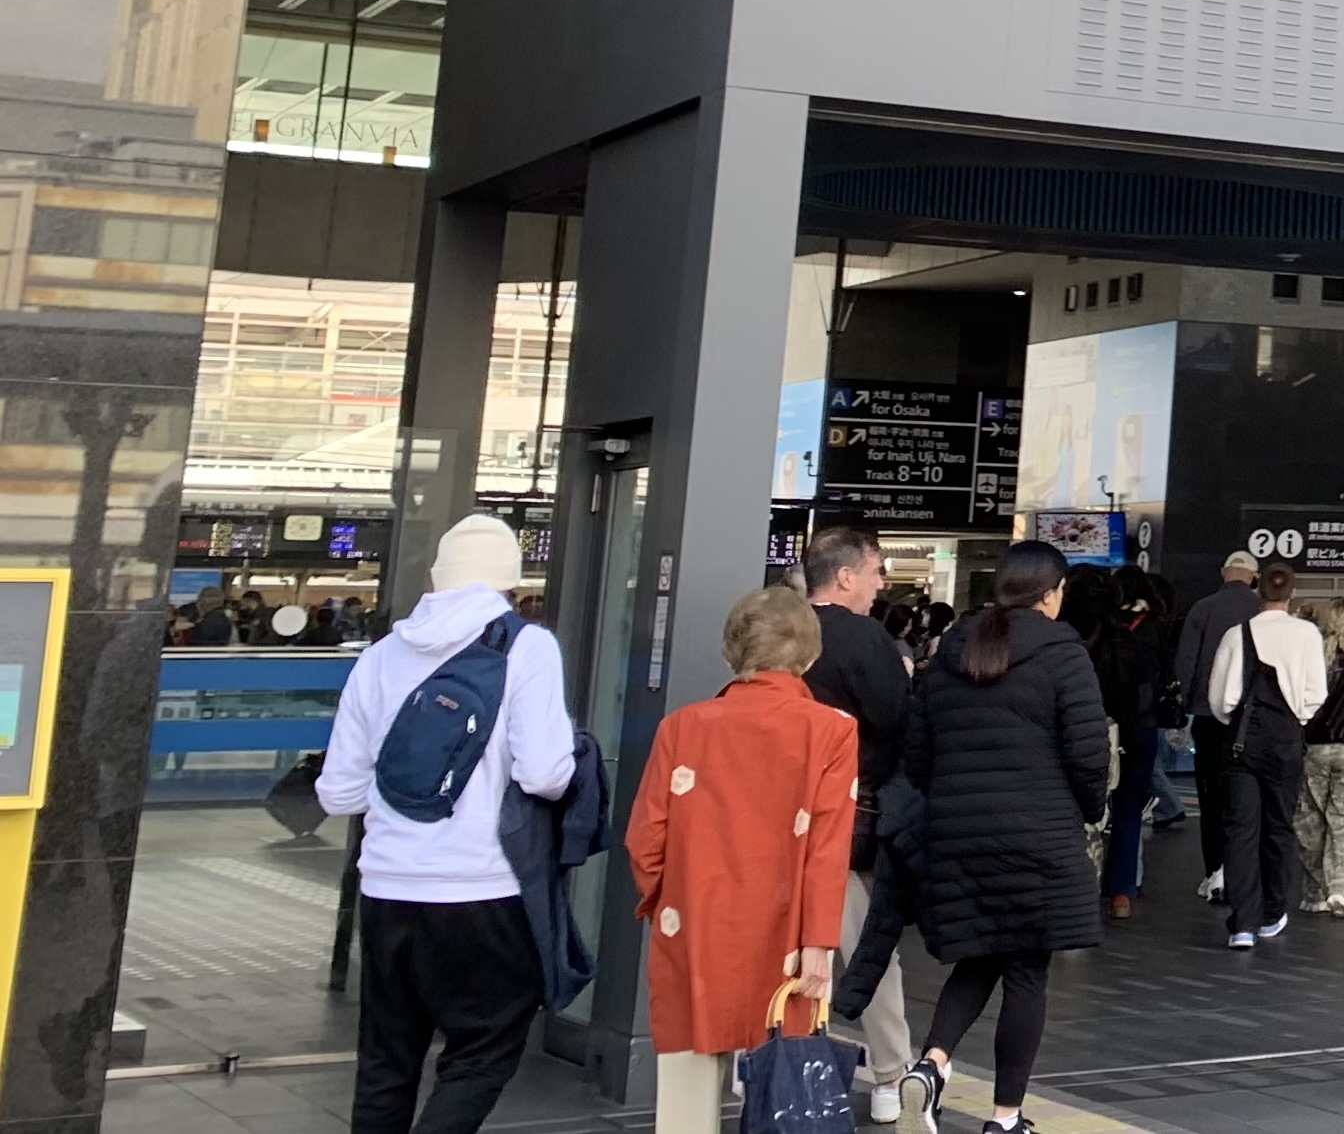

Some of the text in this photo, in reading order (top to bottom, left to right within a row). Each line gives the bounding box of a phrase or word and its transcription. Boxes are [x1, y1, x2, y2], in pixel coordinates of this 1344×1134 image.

[276, 116, 418, 148] GRANVIA
[831, 391, 847, 407] A
[871, 403, 890, 415] for
[987, 401, 998, 417] E
[829, 429, 844, 444] D
[867, 449, 886, 461] for
[938, 453, 966, 464] Nara
[865, 470, 895, 481] Track
